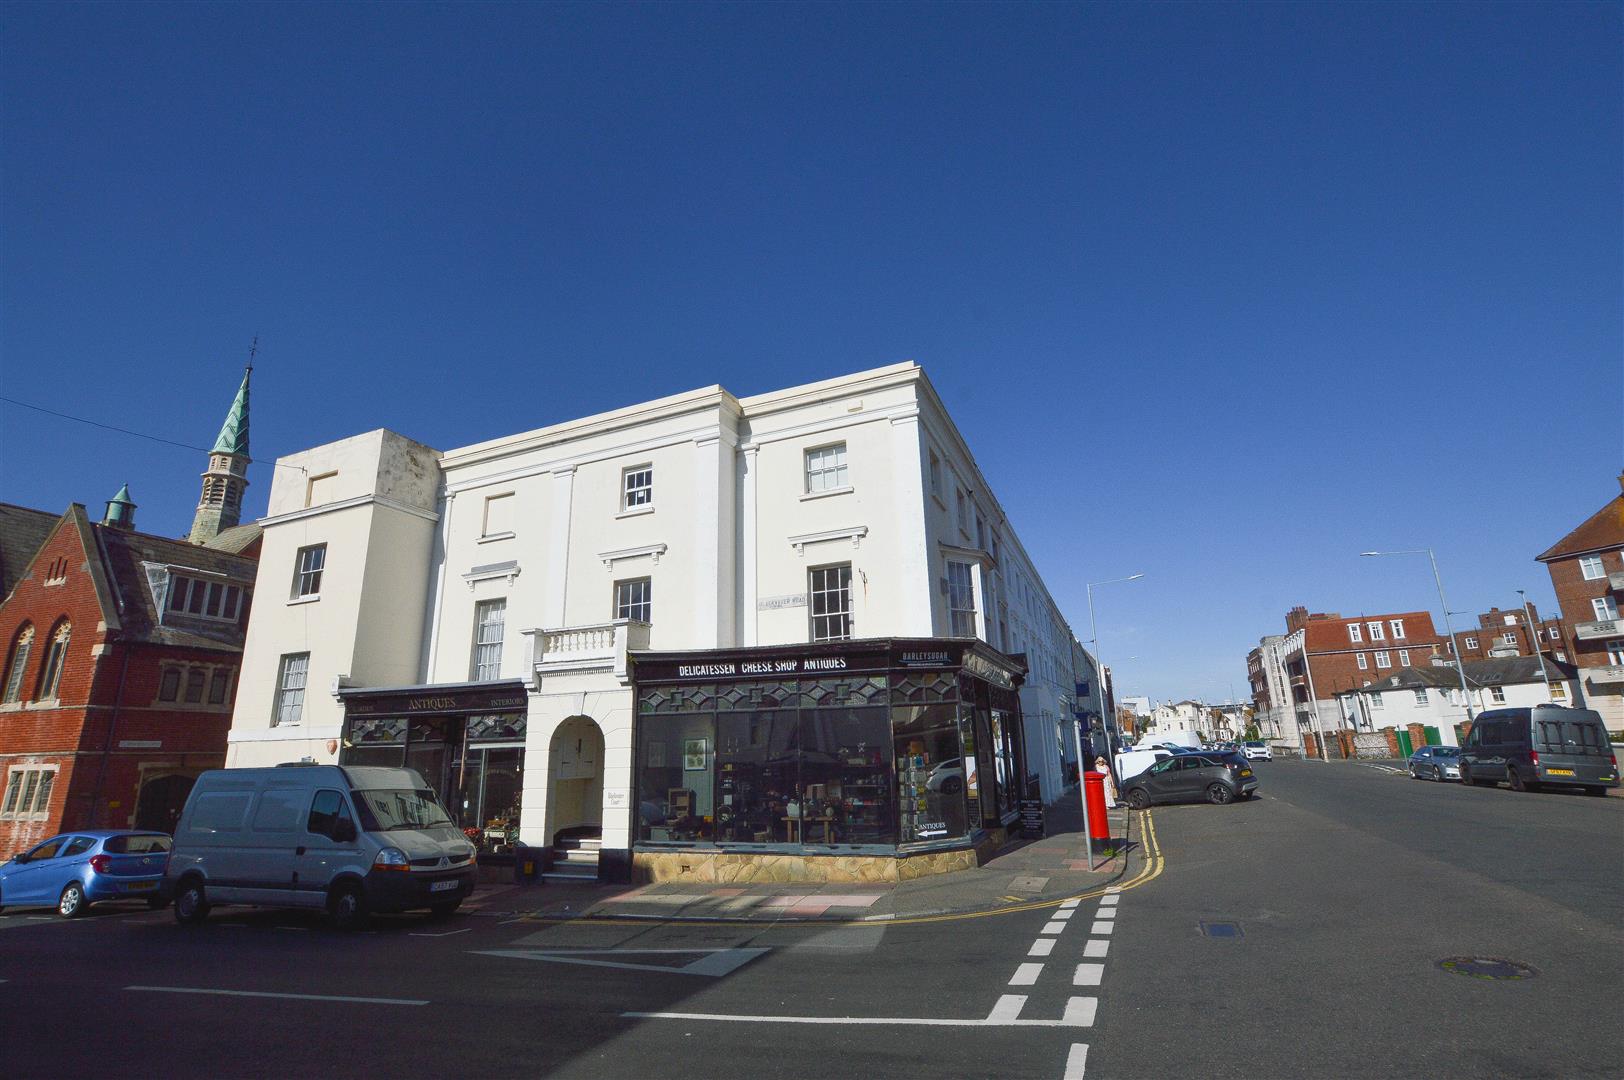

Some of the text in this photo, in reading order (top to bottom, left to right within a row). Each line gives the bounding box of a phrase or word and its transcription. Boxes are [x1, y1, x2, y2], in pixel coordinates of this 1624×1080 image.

[679, 657, 846, 677] DELICATESSEN CHEESE SHOP ANTIQUES
[408, 697, 456, 711] ANTIQUES
[919, 822, 946, 830] ANTIQUES
